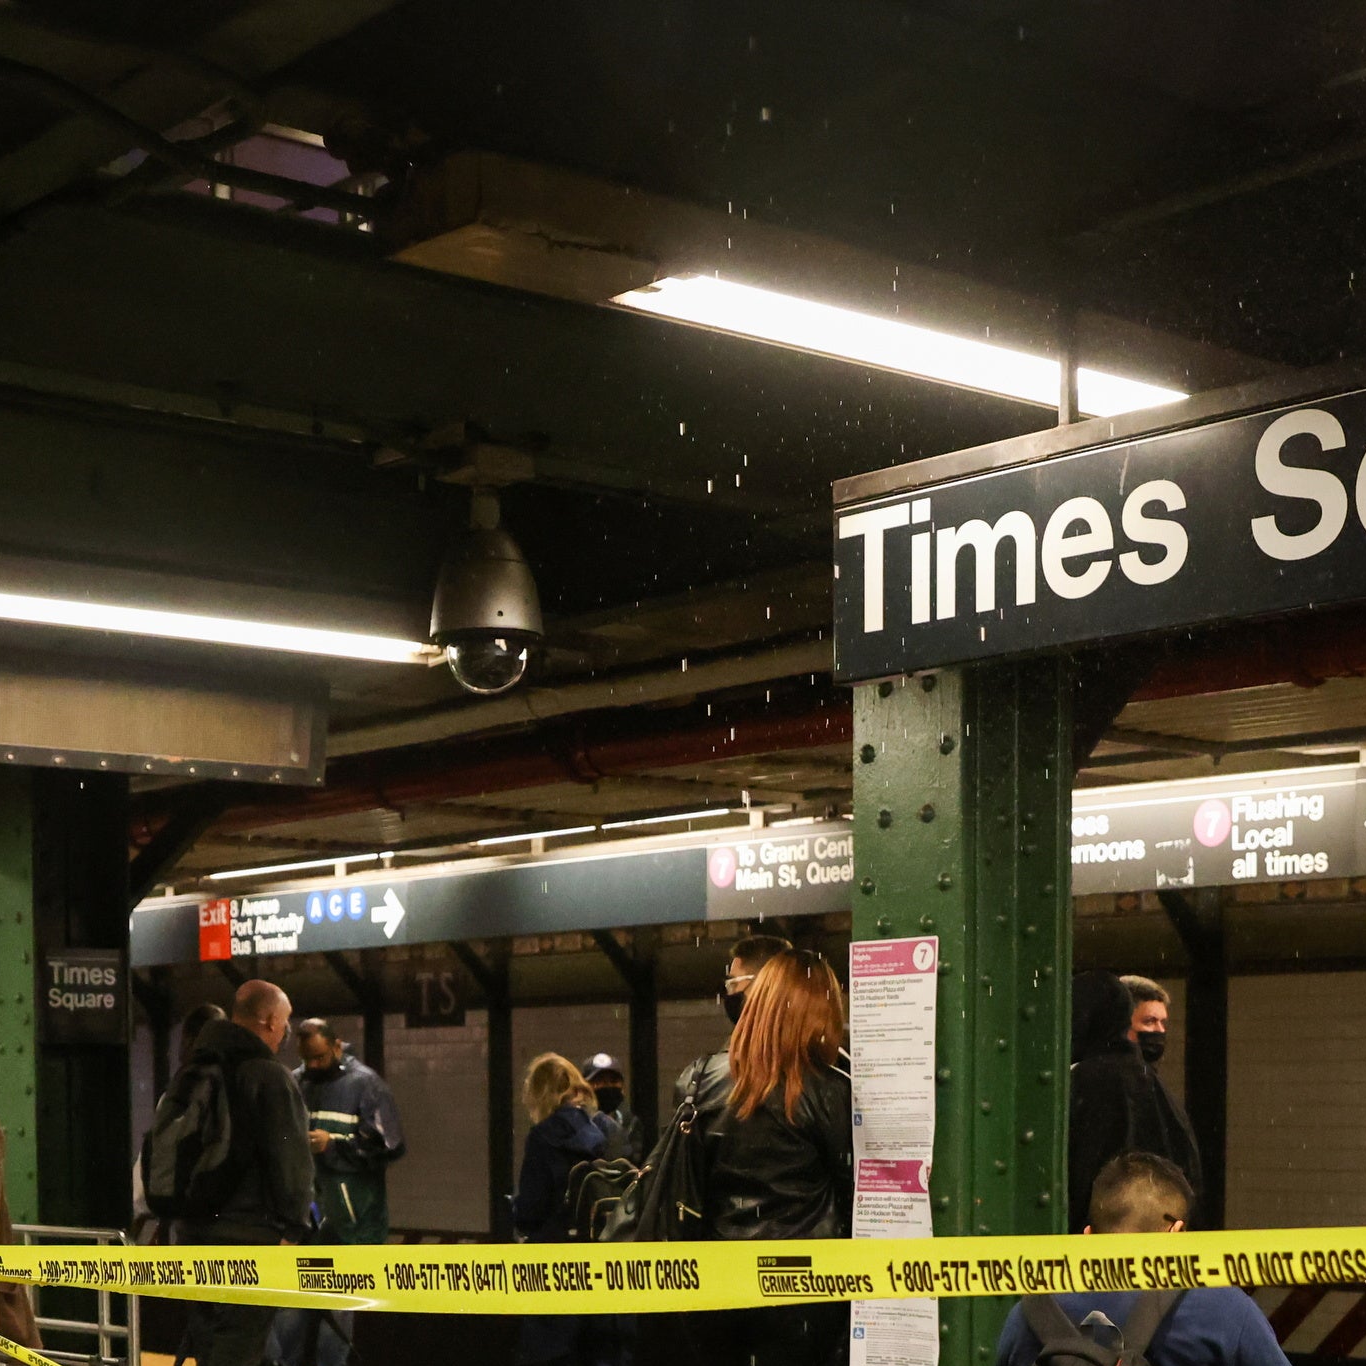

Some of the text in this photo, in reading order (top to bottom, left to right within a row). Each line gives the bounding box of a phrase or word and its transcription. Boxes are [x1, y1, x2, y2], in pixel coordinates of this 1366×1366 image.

[837, 499, 1190, 633] Times
[1232, 792, 1324, 822] Flushing
[1203, 811, 1220, 837] 7
[1232, 821, 1293, 850] Local
[736, 844, 755, 867] To
[760, 839, 809, 866] Grand
[1071, 838, 1146, 864] rnoons
[715, 856, 729, 880] 7
[736, 869, 773, 891] Main
[778, 864, 802, 890] St,
[1232, 850, 1328, 879] all times
[200, 902, 228, 927] Exit
[230, 899, 280, 917] 8 Avenue
[310, 892, 362, 918] A C E
[231, 912, 305, 936] Port Authority
[231, 933, 298, 955] Bus Terminal
[920, 948, 927, 963] 7
[48, 961, 117, 986] Times
[48, 988, 115, 1011] Square
[39, 1260, 99, 1284] 1-800-577-TIPS
[100, 1258, 127, 1286] (8477)
[129, 1261, 156, 1285] CRIME
[157, 1260, 185, 1285] SCENE
[193, 1260, 207, 1284] DO
[207, 1260, 227, 1285] NOT
[227, 1259, 259, 1285] CROSS
[758, 1257, 777, 1266] NYPD
[886, 1259, 1013, 1292] 1-800-577-TIPS
[1018, 1255, 1076, 1294] (8477)
[1080, 1257, 1140, 1290] CRIME
[1142, 1255, 1205, 1289] SCENE
[1223, 1253, 1254, 1287] DO
[1256, 1251, 1297, 1285] NOT
[383, 1263, 470, 1291] 1-800-577-TIPS
[472, 1259, 508, 1294] (8477)
[512, 1263, 551, 1292] CRIME
[552, 1261, 593, 1292] SCENE
[605, 1260, 623, 1291] DO
[626, 1259, 652, 1290] NOT
[655, 1258, 700, 1291] CROSS
